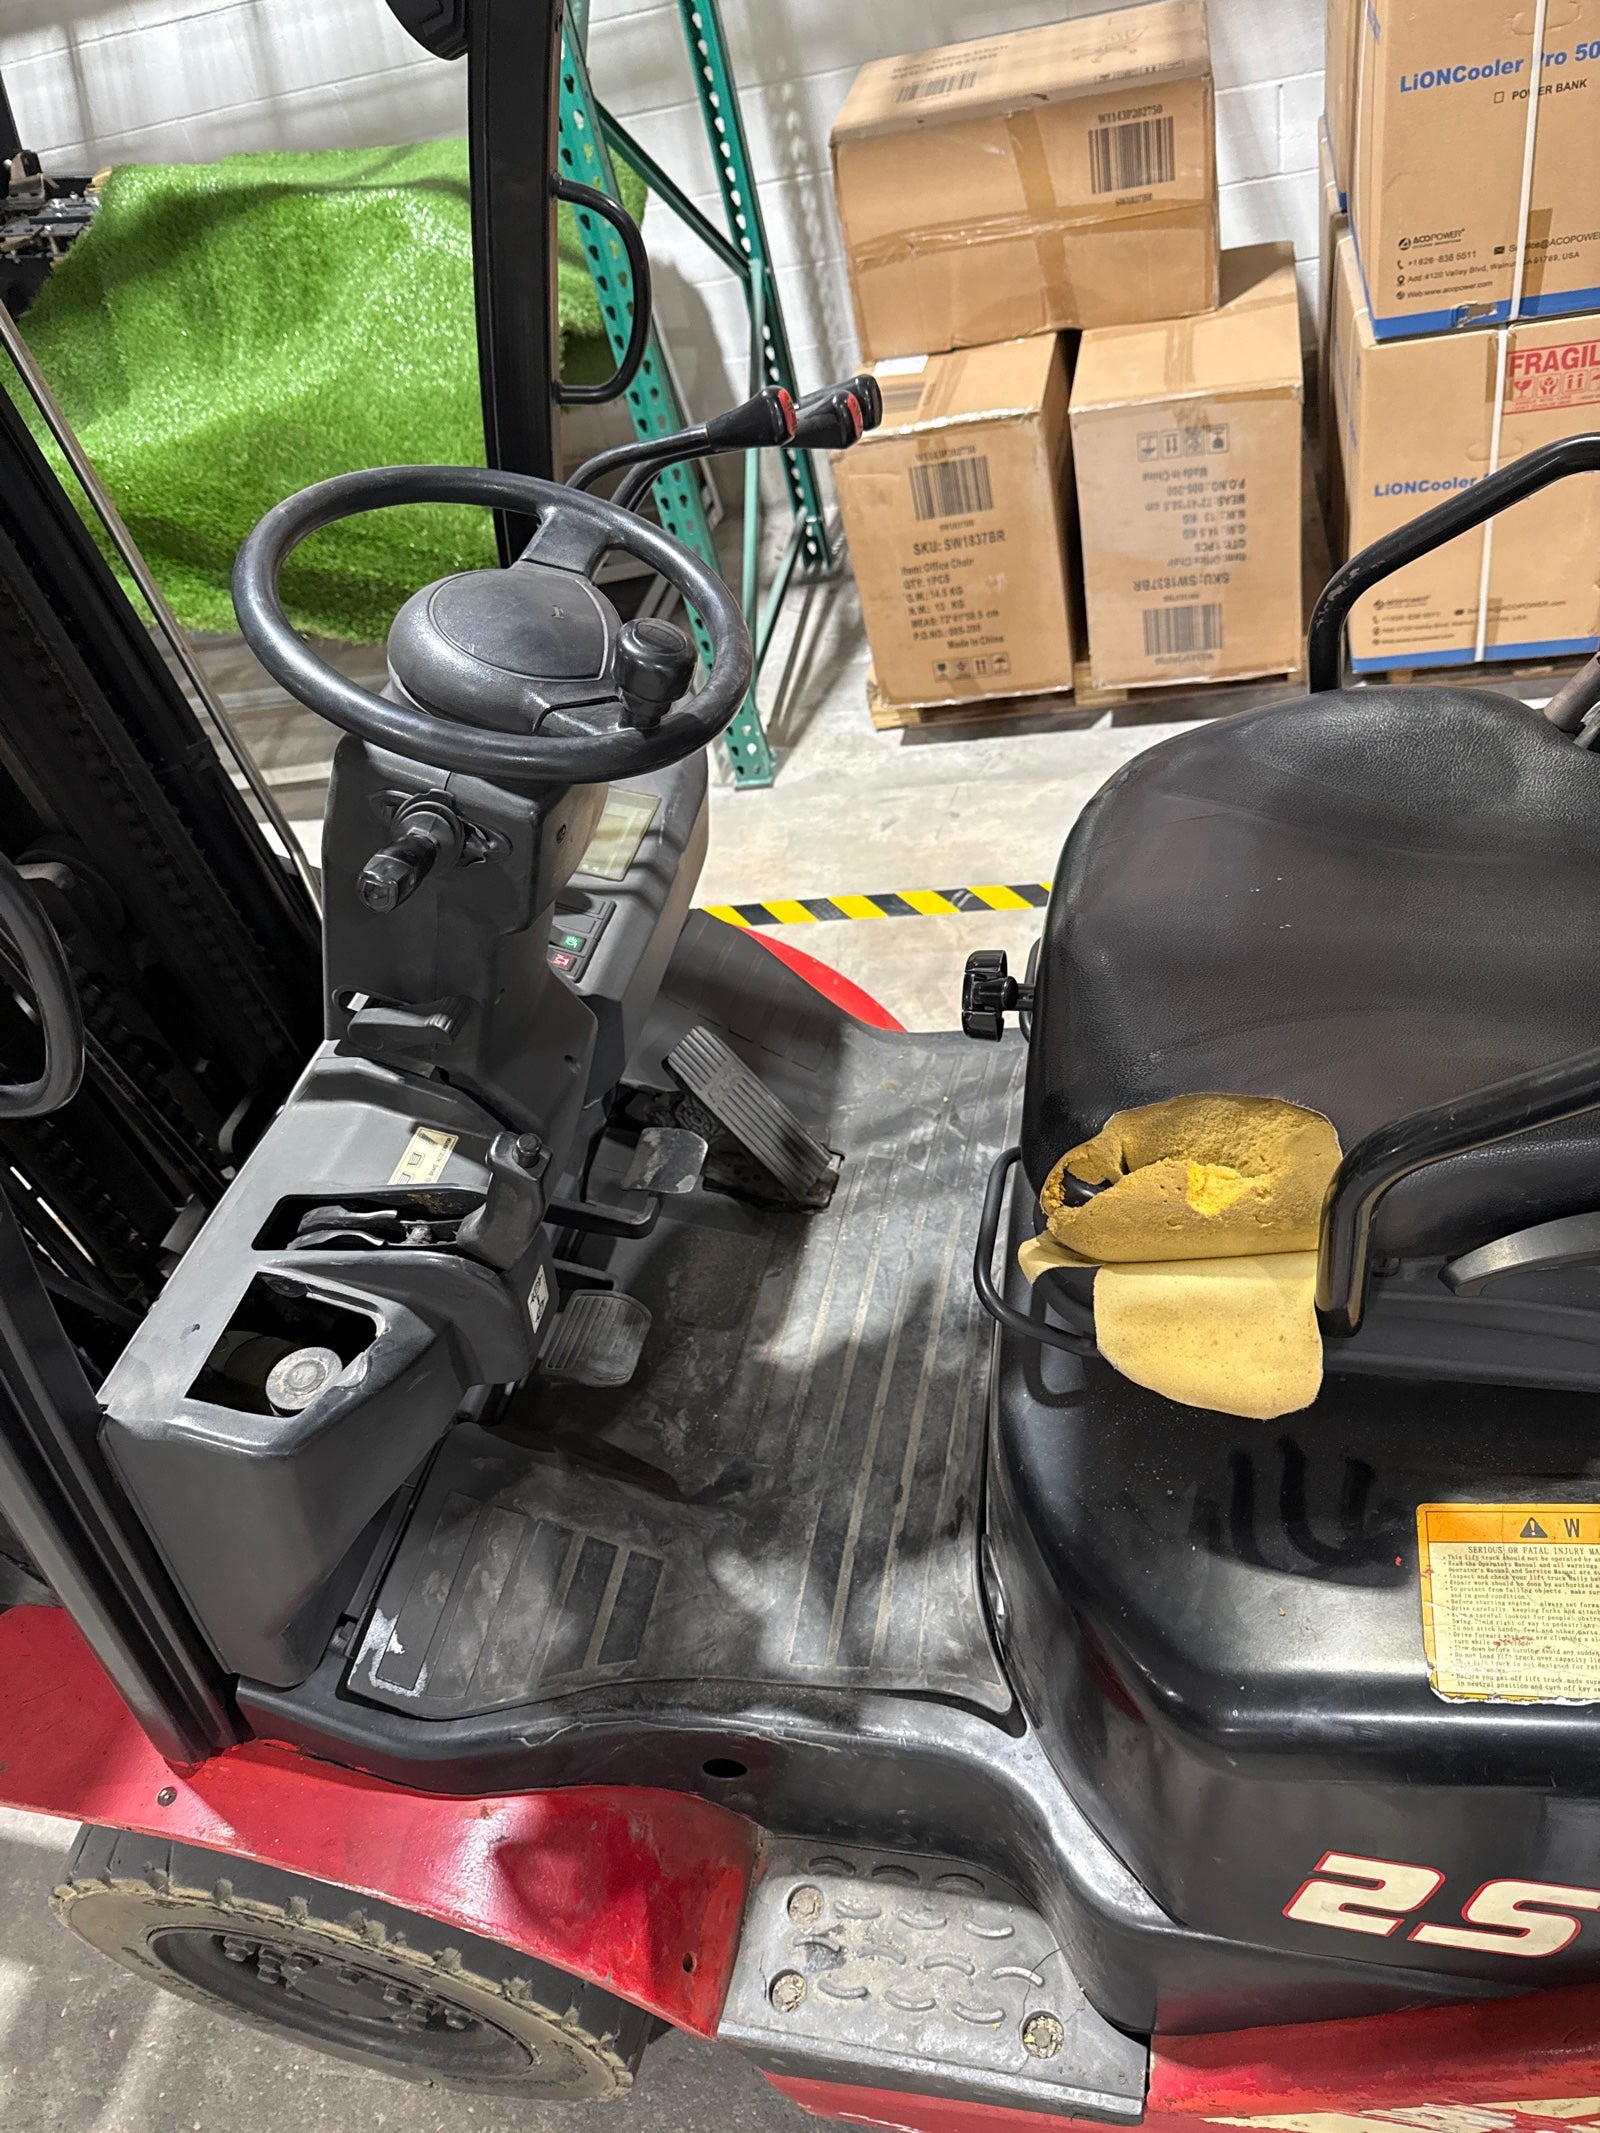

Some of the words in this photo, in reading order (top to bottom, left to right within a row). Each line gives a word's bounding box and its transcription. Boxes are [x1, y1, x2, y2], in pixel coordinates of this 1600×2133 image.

[1400, 58, 1524, 92] LiONCooler
[1512, 84, 1552, 100] POER
[1556, 79, 1587, 93] BANK
[1456, 251, 1476, 261] 5511
[1445, 268, 1467, 278] Valley
[1562, 252, 1580, 260] USA
[1374, 477, 1478, 497] LiONCooler
[913, 542, 942, 556] SKU:
[944, 530, 1006, 551] SW1837BR
[924, 561, 949, 572] Office
[951, 558, 974, 569] Chair
[1133, 574, 1198, 591] SW1837BR
[947, 640, 969, 650] Made
[979, 635, 1004, 647] China
[1468, 1546, 1503, 1554] SERIOUS
[1555, 1655, 1588, 1663] capacity
